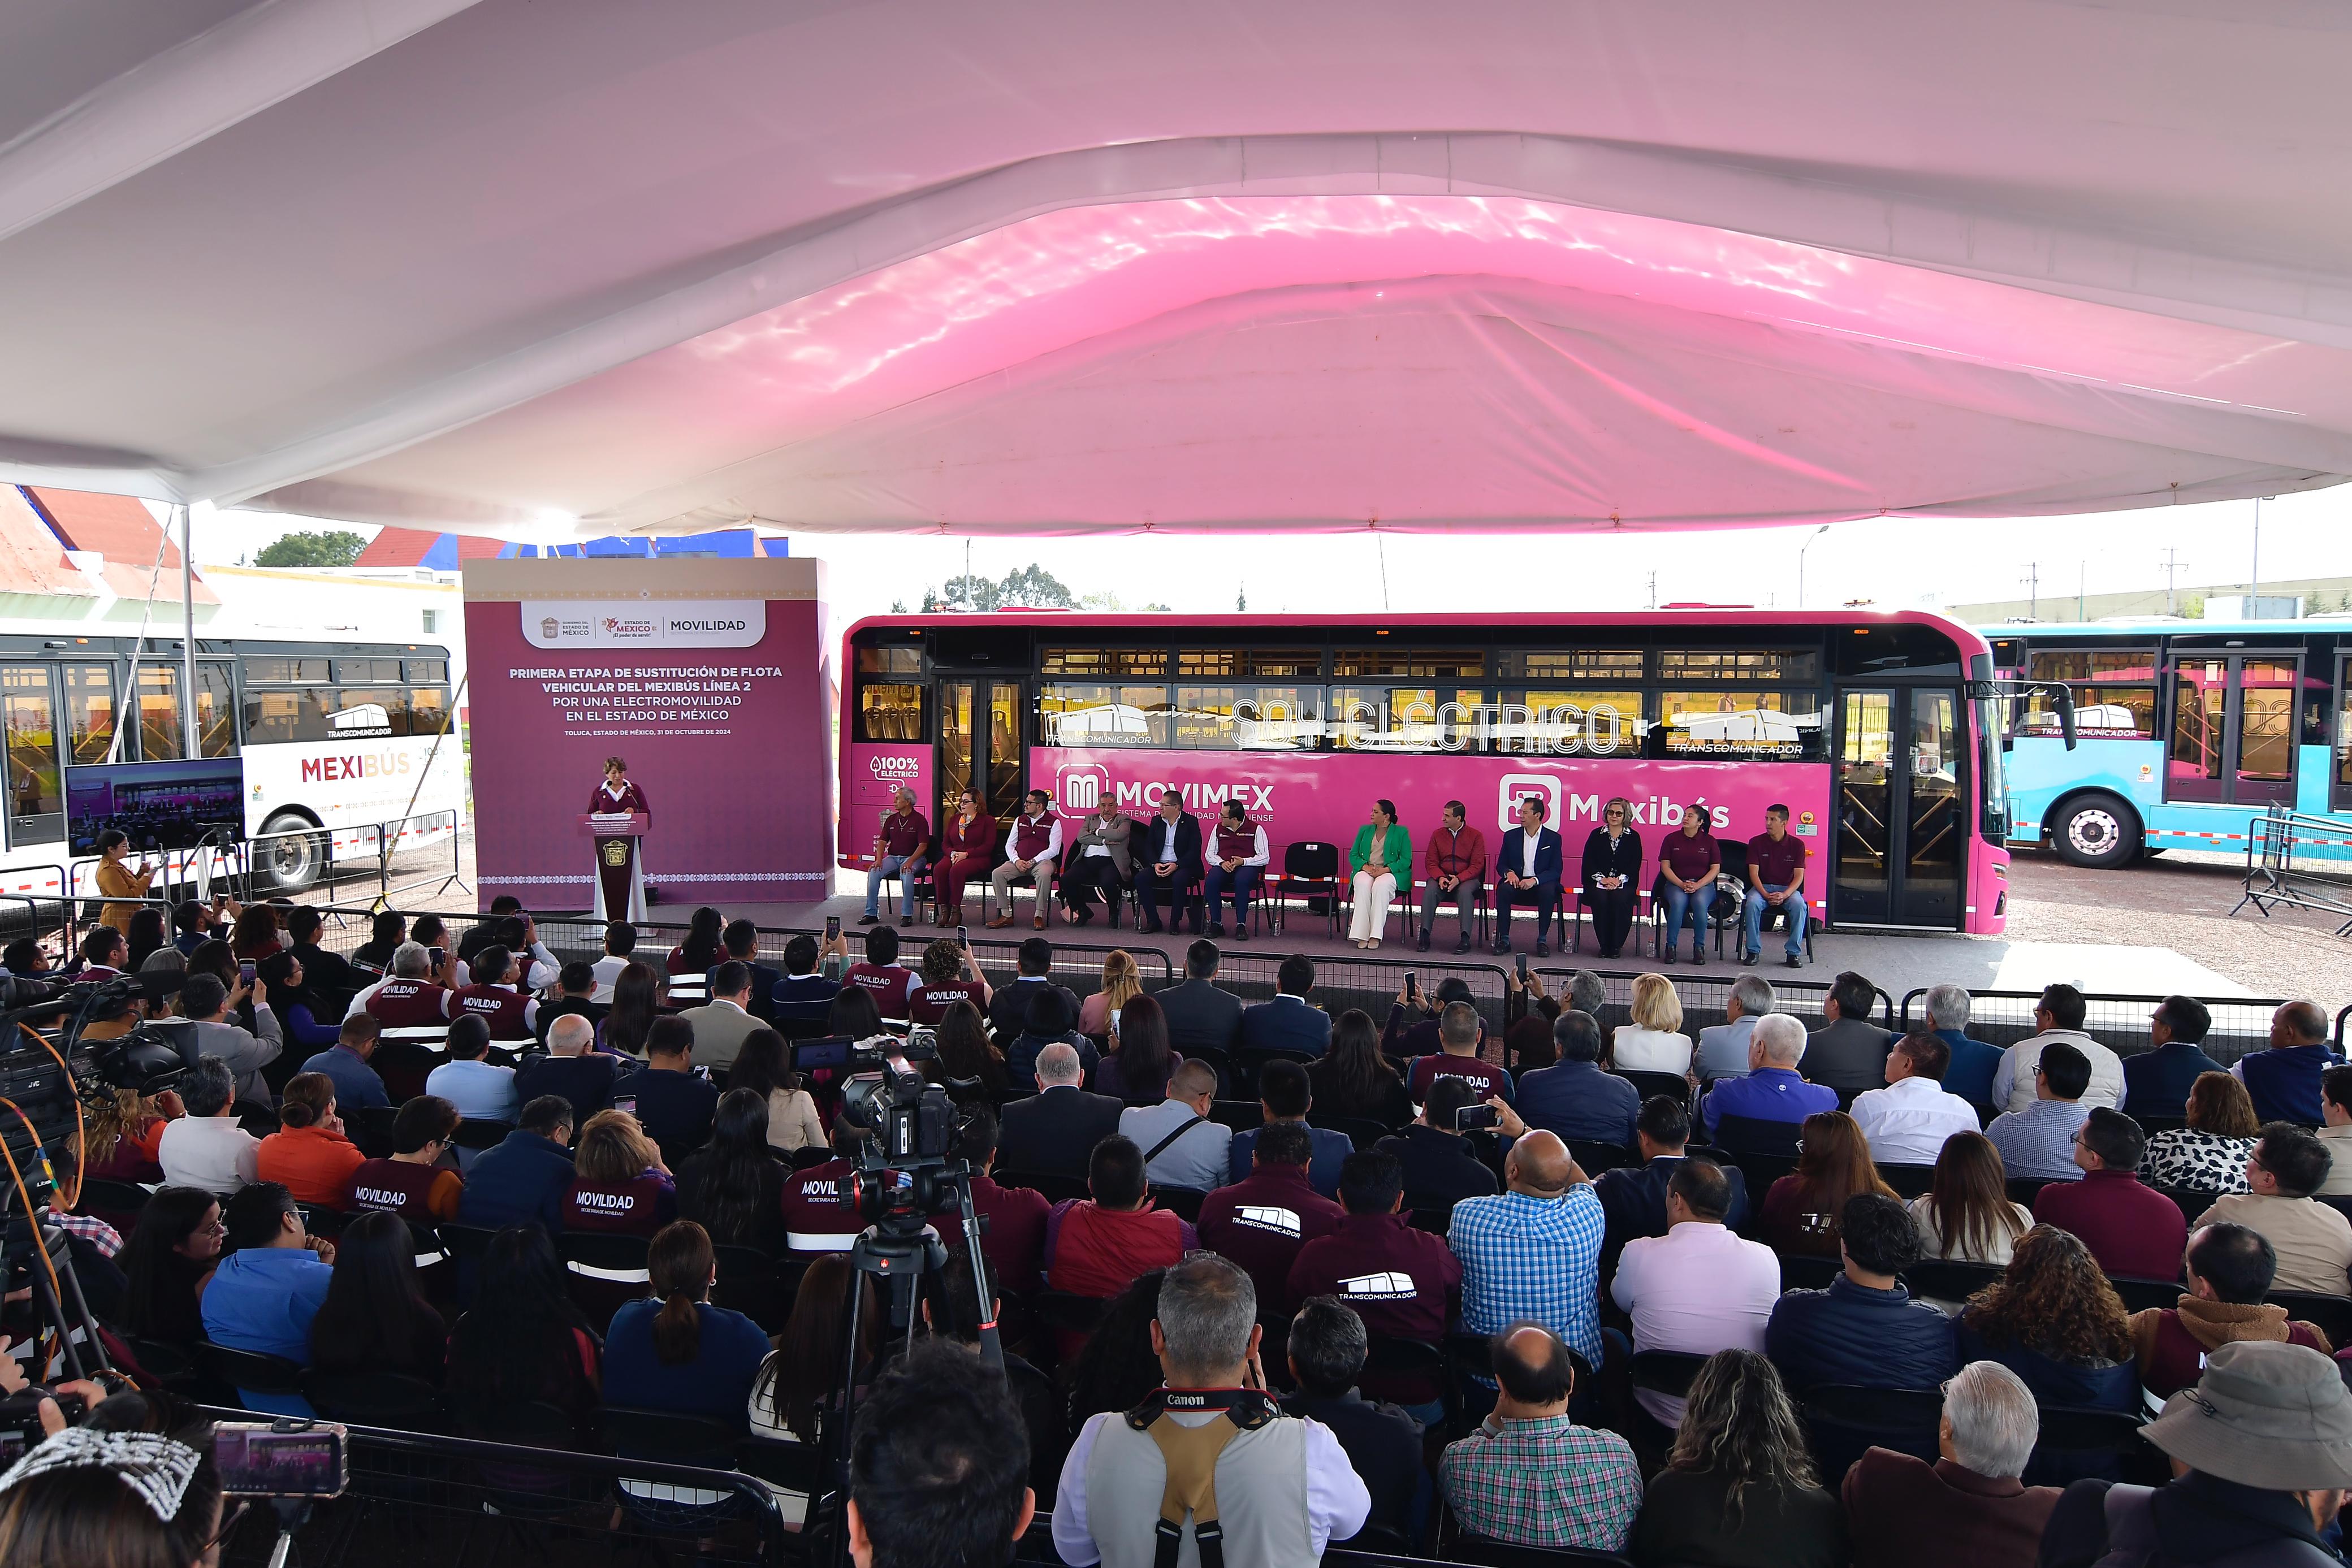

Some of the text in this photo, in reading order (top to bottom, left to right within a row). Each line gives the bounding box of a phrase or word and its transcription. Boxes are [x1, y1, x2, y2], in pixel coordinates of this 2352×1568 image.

[671, 620, 746, 630] MOVILIDAD
[510, 665, 782, 678] PRIMERA ETAPA DE SUSTITUCIÓN DE FLOTA
[542, 679, 751, 692] VEHICULAR DEL MEXIBÚS LÍNEA 2
[553, 696, 742, 707] POR UNA ELECTROMOVILIDAD
[567, 708, 729, 721] EN EL ESTADO DE MÉXICO
[1230, 690, 1621, 755] SOY ELÉCTRICO
[327, 727, 392, 738] TRANSCOMUNICADOR
[2042, 728, 2137, 738] TRANOMUNICADOR
[1048, 734, 1152, 744] TRANSCOMUNICADOR
[1673, 743, 1804, 754] TRANSCOMUNICADOR
[301, 747, 410, 783] MEXIBÚS
[881, 757, 919, 770] 100%
[881, 769, 919, 778] ELÉCTRICO
[853, 973, 890, 985] MOVILIDAD
[926, 990, 969, 1000] MOVILIDAD
[463, 997, 501, 1009] MOVILIDAD
[1434, 1072, 1490, 1088] MIDAD
[801, 1181, 838, 1194] MOVIL
[356, 1186, 407, 1205] MOVILIDAD
[576, 1191, 634, 1209] MOVILIDAD
[1232, 1217, 1300, 1239] TRANSCOMUNICADOR
[1339, 1291, 1417, 1300] TRANSCOMUNICADOR
[1167, 1394, 1204, 1405] Canon
